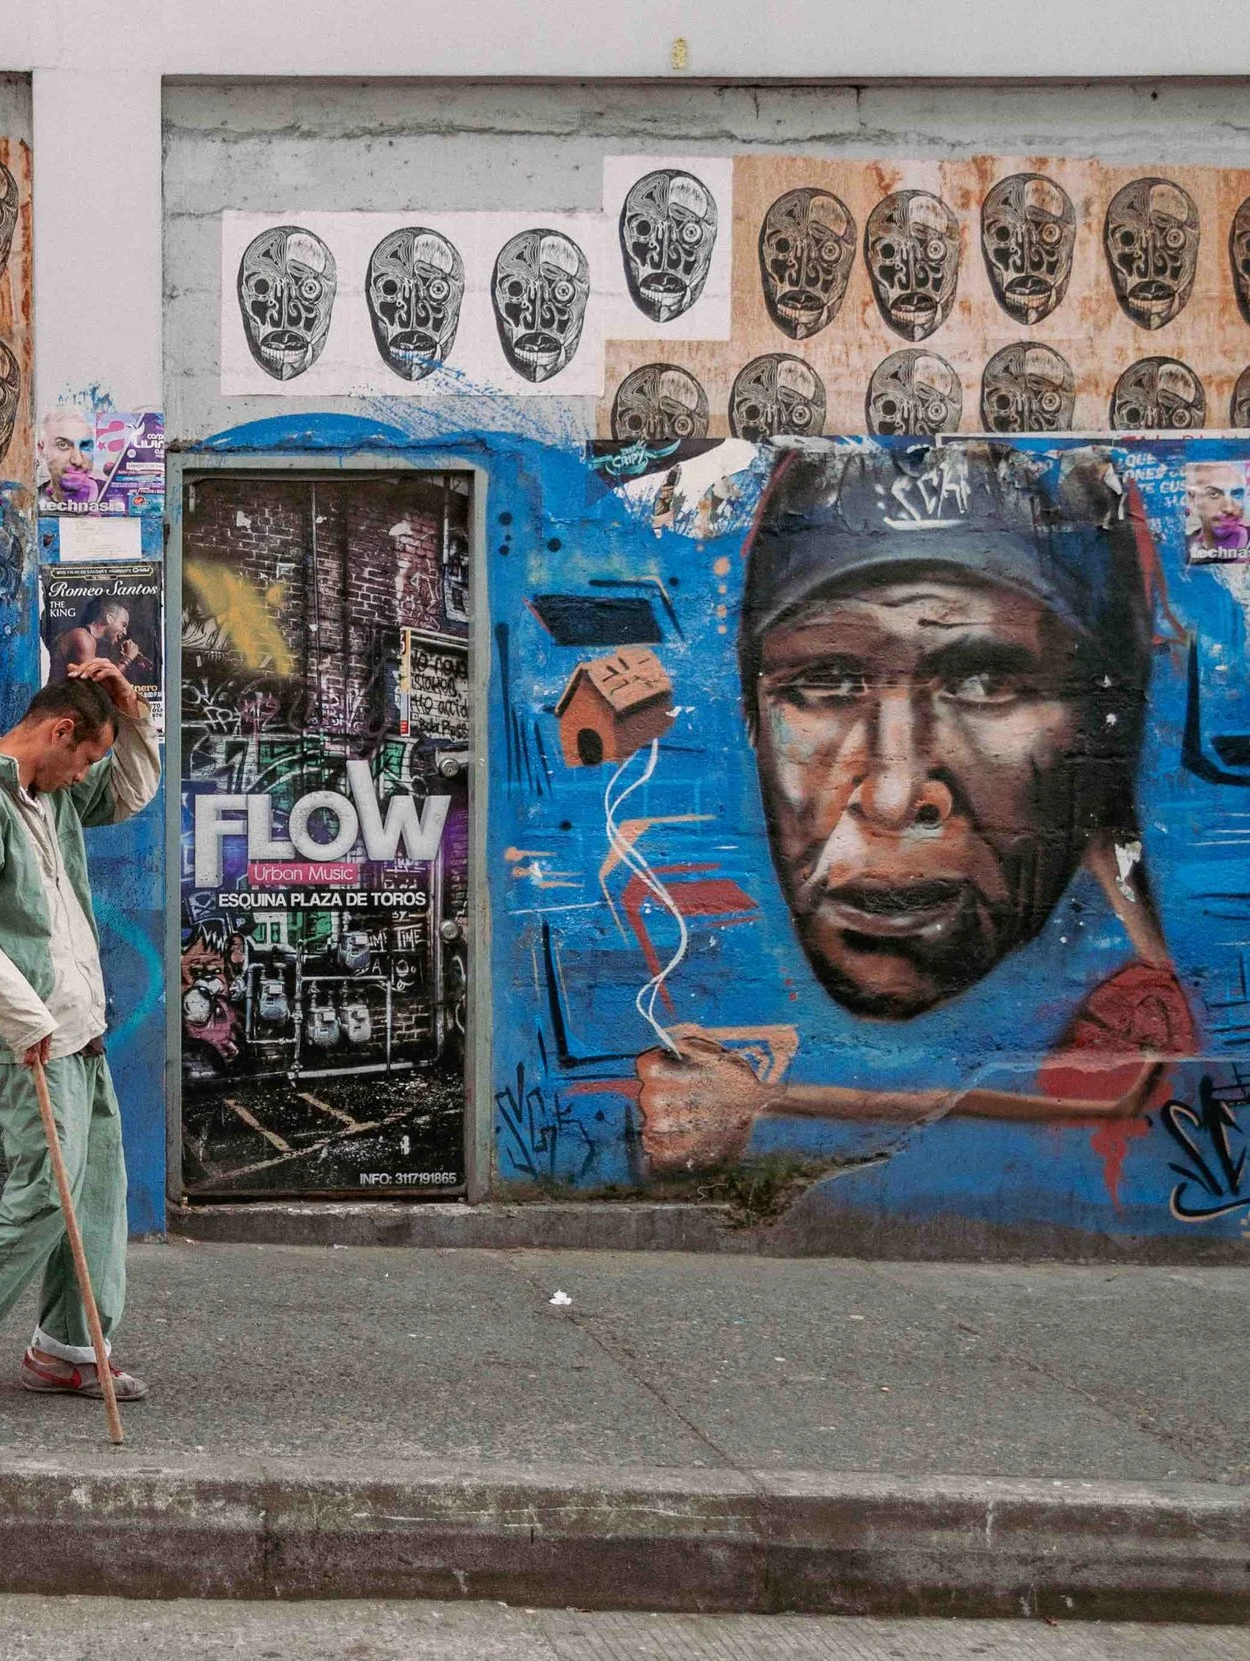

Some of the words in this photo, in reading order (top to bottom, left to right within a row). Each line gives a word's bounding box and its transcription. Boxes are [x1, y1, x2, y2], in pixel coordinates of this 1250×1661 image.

[38, 498, 125, 513] technasia
[1189, 545, 1250, 559] techna
[48, 581, 104, 597] Romeo
[105, 579, 159, 596] Santos
[49, 600, 66, 609] THE
[49, 608, 77, 618] KING
[131, 684, 159, 692] nero
[195, 759, 452, 888] FLOW
[253, 865, 303, 882] Urban
[308, 865, 354, 881] Music
[218, 892, 288, 910] ESQUINA
[290, 892, 344, 907] PLAZA
[345, 891, 368, 907] DE
[370, 891, 427, 907] TOROS
[359, 1172, 393, 1185] INFO:
[394, 1172, 457, 1185] 3117191865
